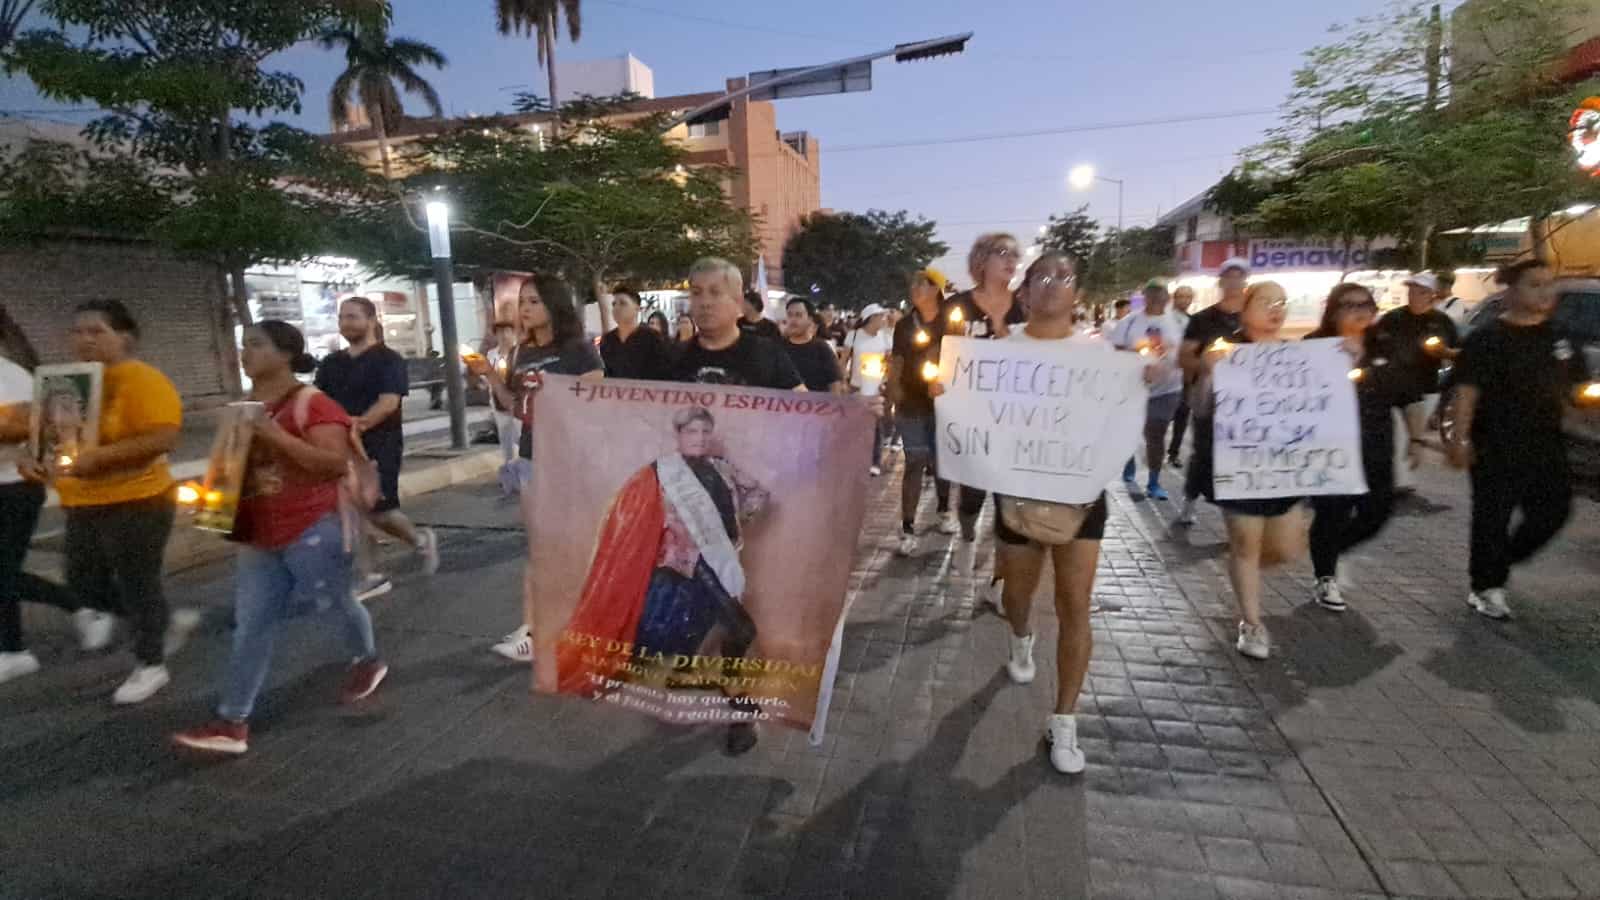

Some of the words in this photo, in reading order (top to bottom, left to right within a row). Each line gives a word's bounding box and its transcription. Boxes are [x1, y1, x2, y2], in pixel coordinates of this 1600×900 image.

[989, 400, 1070, 430] VIVIR
[946, 422, 990, 456] SIN
[608, 639, 633, 656] DE
[640, 646, 665, 665] LA
[665, 692, 697, 705] hay
[700, 694, 730, 707] que
